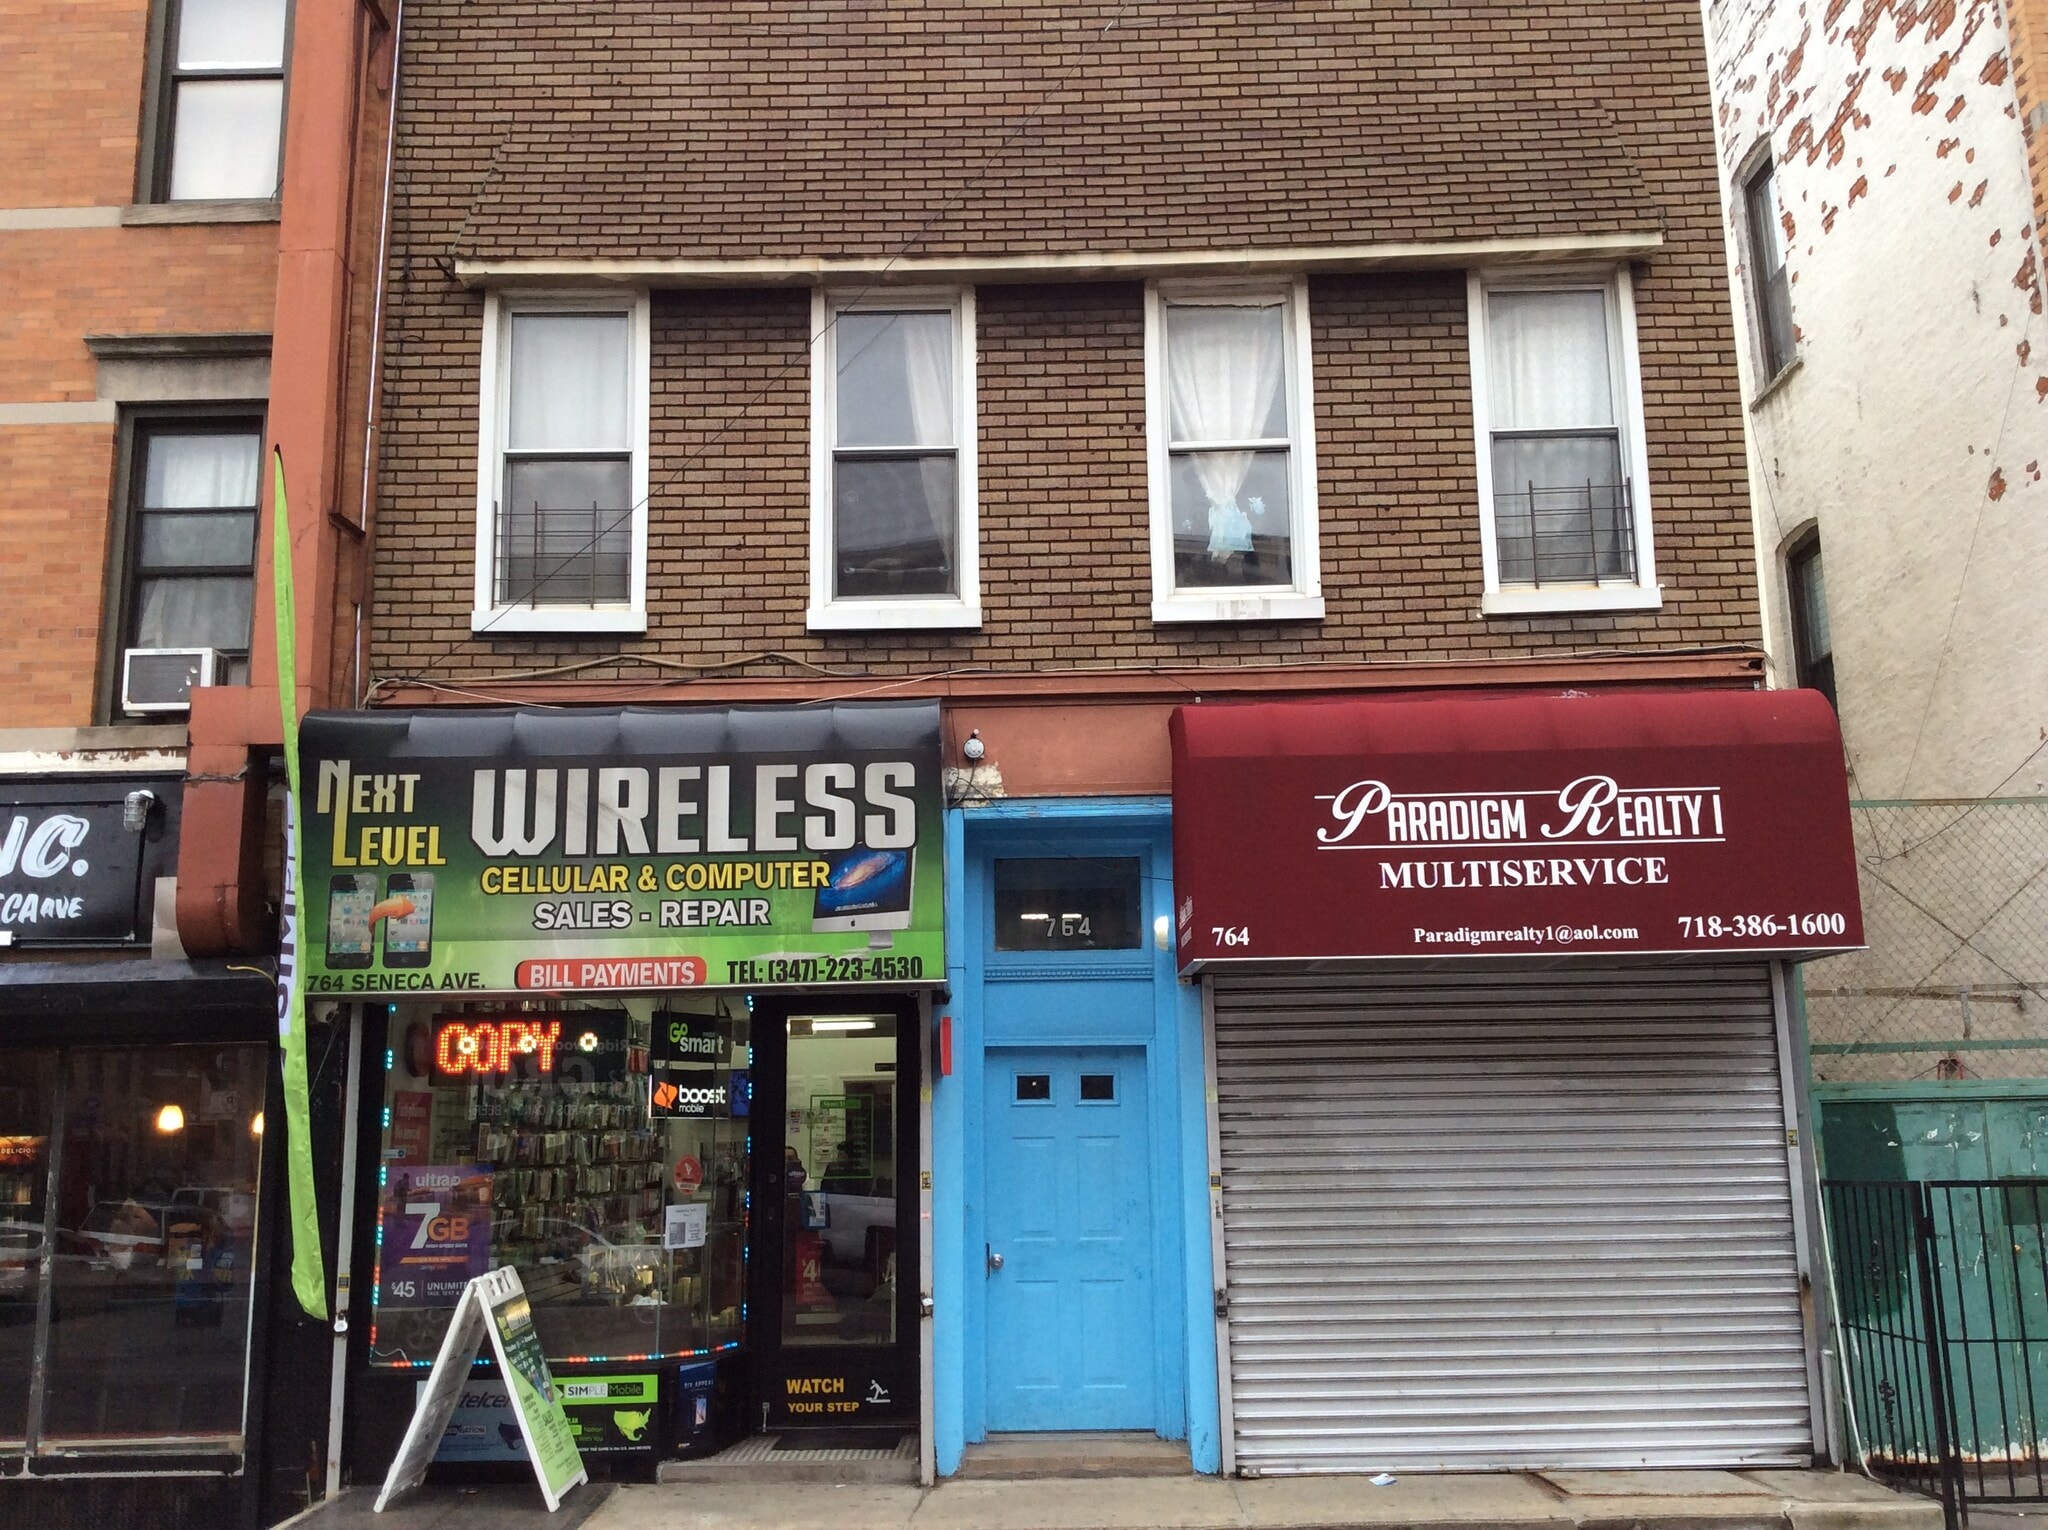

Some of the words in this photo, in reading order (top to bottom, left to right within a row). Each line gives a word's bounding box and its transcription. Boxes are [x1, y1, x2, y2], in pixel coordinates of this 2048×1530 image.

[316, 760, 421, 815] NEXT
[472, 762, 916, 857] WIRELESS
[1316, 779, 1526, 844] PARADIGM
[1540, 775, 1702, 838] REALTY
[331, 825, 447, 868] LEVEL
[480, 865, 630, 894] CELLULAR
[637, 865, 658, 892] &
[665, 861, 832, 890] COMPUTER
[1379, 856, 1669, 890] MULTISERVICE
[0, 893, 39, 924] CA
[40, 896, 84, 919] AVE
[533, 901, 632, 930] SALES
[659, 898, 771, 927] REPAIR
[1045, 918, 1091, 937] 764
[1211, 926, 1250, 946] 764
[1413, 924, 1638, 946] Paradigmrealty1@aol.com
[1677, 911, 1846, 938] 718-386-1600
[529, 964, 574, 989] BILL
[580, 961, 695, 988] PAYMENTS
[727, 960, 763, 984] TEL:
[767, 956, 922, 984] (347)-223-4530
[306, 974, 345, 992] 764
[351, 974, 434, 991] SENECA
[440, 973, 486, 990] AVE.
[670, 1022, 688, 1043] Go
[437, 1020, 560, 1075] COPY
[679, 1084, 726, 1104] boost
[679, 1104, 704, 1113] mobile
[391, 1281, 416, 1298] $45
[427, 1281, 468, 1291] UNLIMITE
[568, 1386, 606, 1396] SIMPLE
[609, 1384, 642, 1395] Mobile
[786, 1379, 845, 1395] WATCH
[788, 1403, 824, 1413] YOUR
[827, 1402, 860, 1413] STEP
